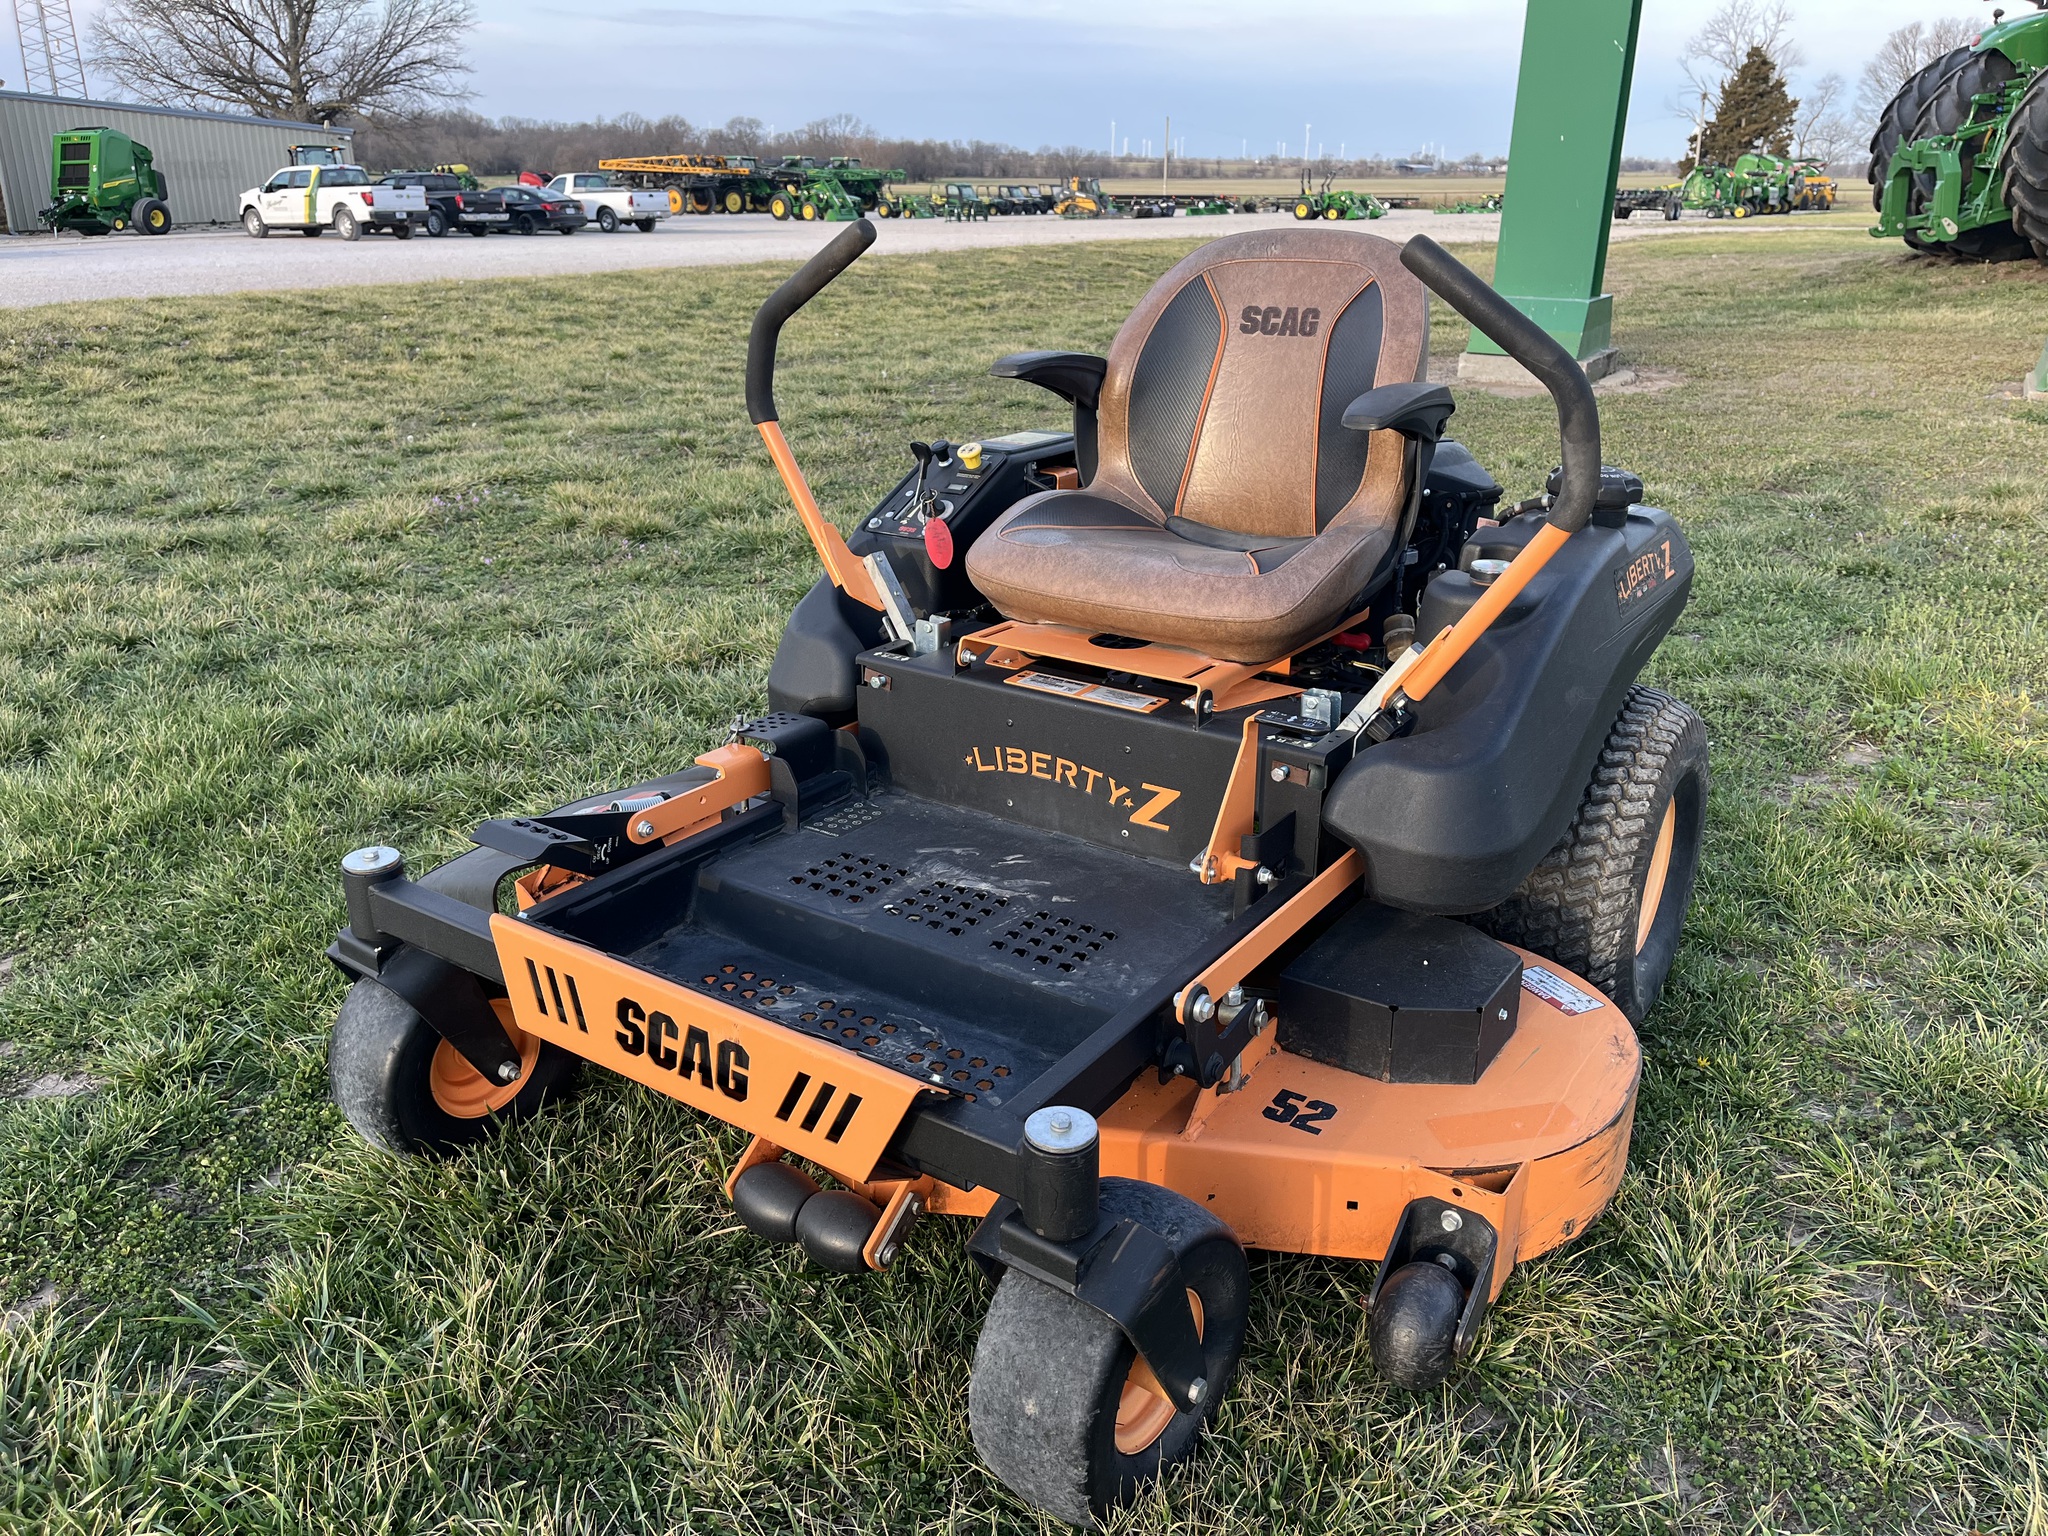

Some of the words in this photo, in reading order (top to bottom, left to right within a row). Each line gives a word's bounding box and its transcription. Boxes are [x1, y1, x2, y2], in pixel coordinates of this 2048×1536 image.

[1239, 305, 1321, 337] SCAG
[1661, 540, 1675, 580] Z
[972, 746, 1131, 806] LIBERTY
[1129, 782, 1181, 832] Z
[616, 997, 751, 1103] SCAG
[1261, 1087, 1339, 1136] 52
